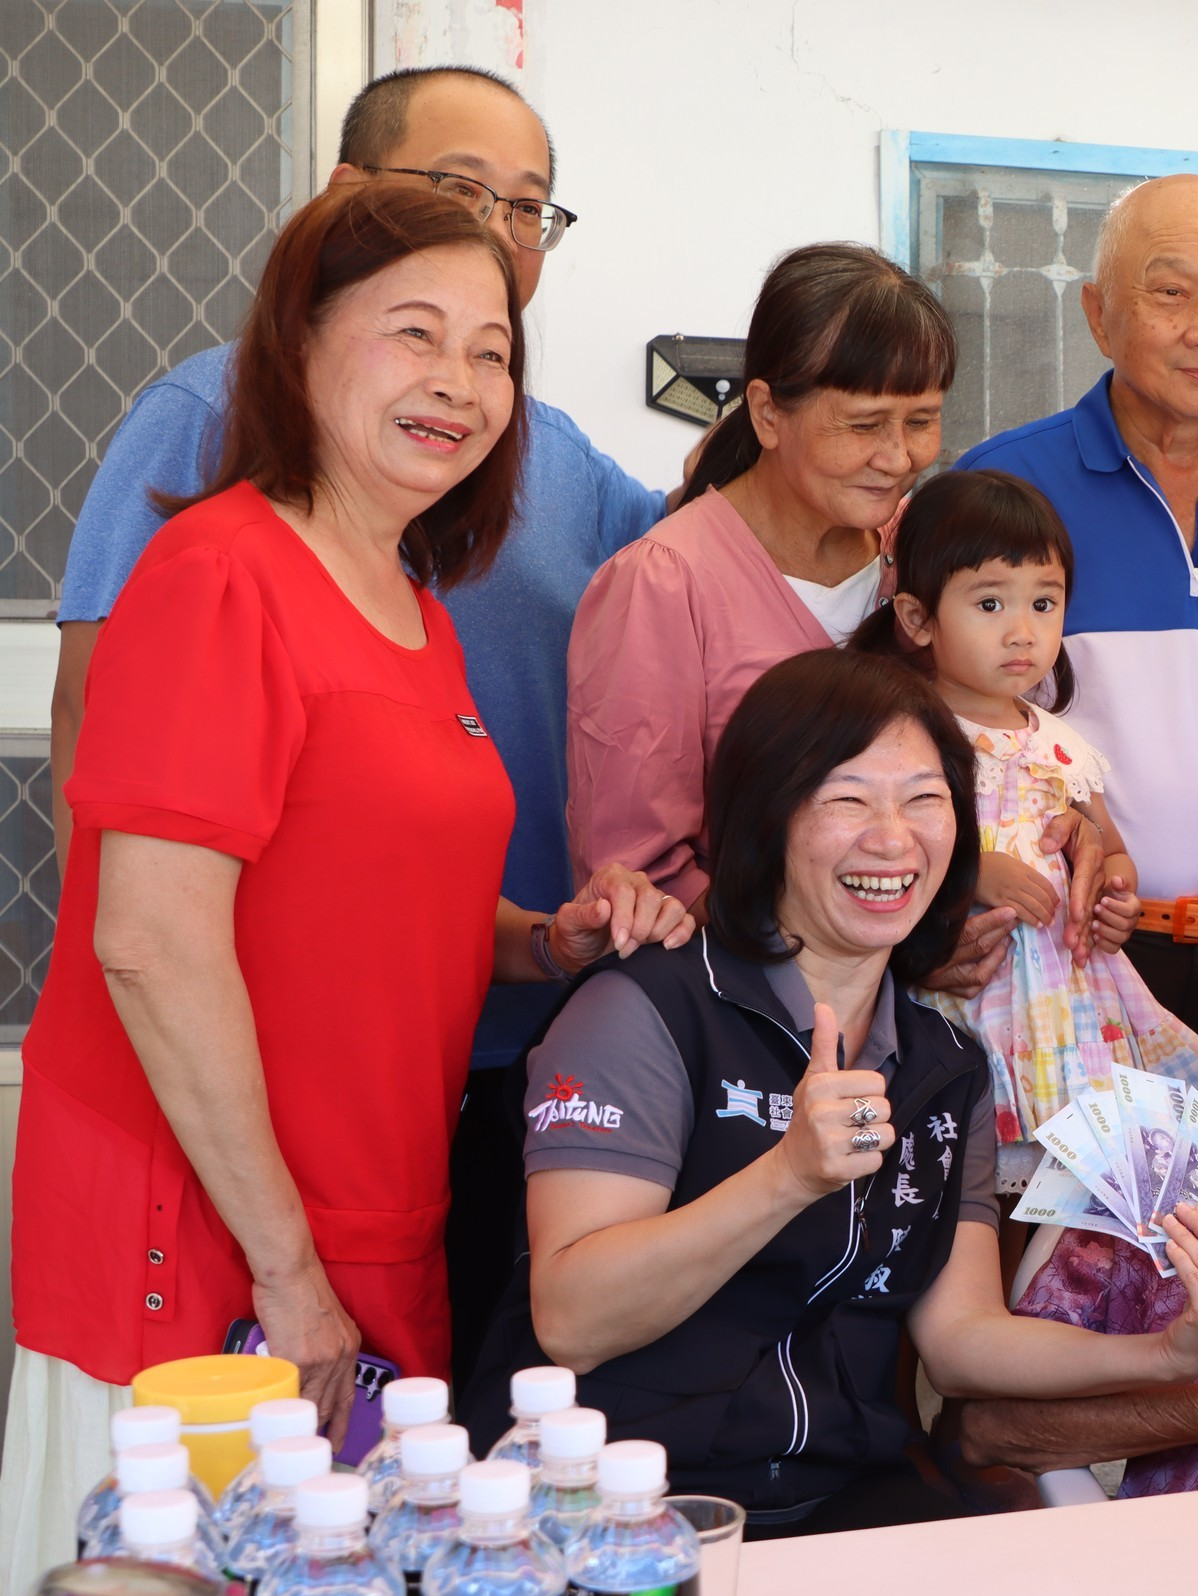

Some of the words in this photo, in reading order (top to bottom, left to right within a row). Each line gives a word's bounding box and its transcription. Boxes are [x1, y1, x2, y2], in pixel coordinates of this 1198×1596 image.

[1119, 1072, 1133, 1103] 1000
[1088, 1102, 1111, 1134] 1000
[1046, 1132, 1077, 1160] 1000
[1023, 1206, 1056, 1217] 1000
